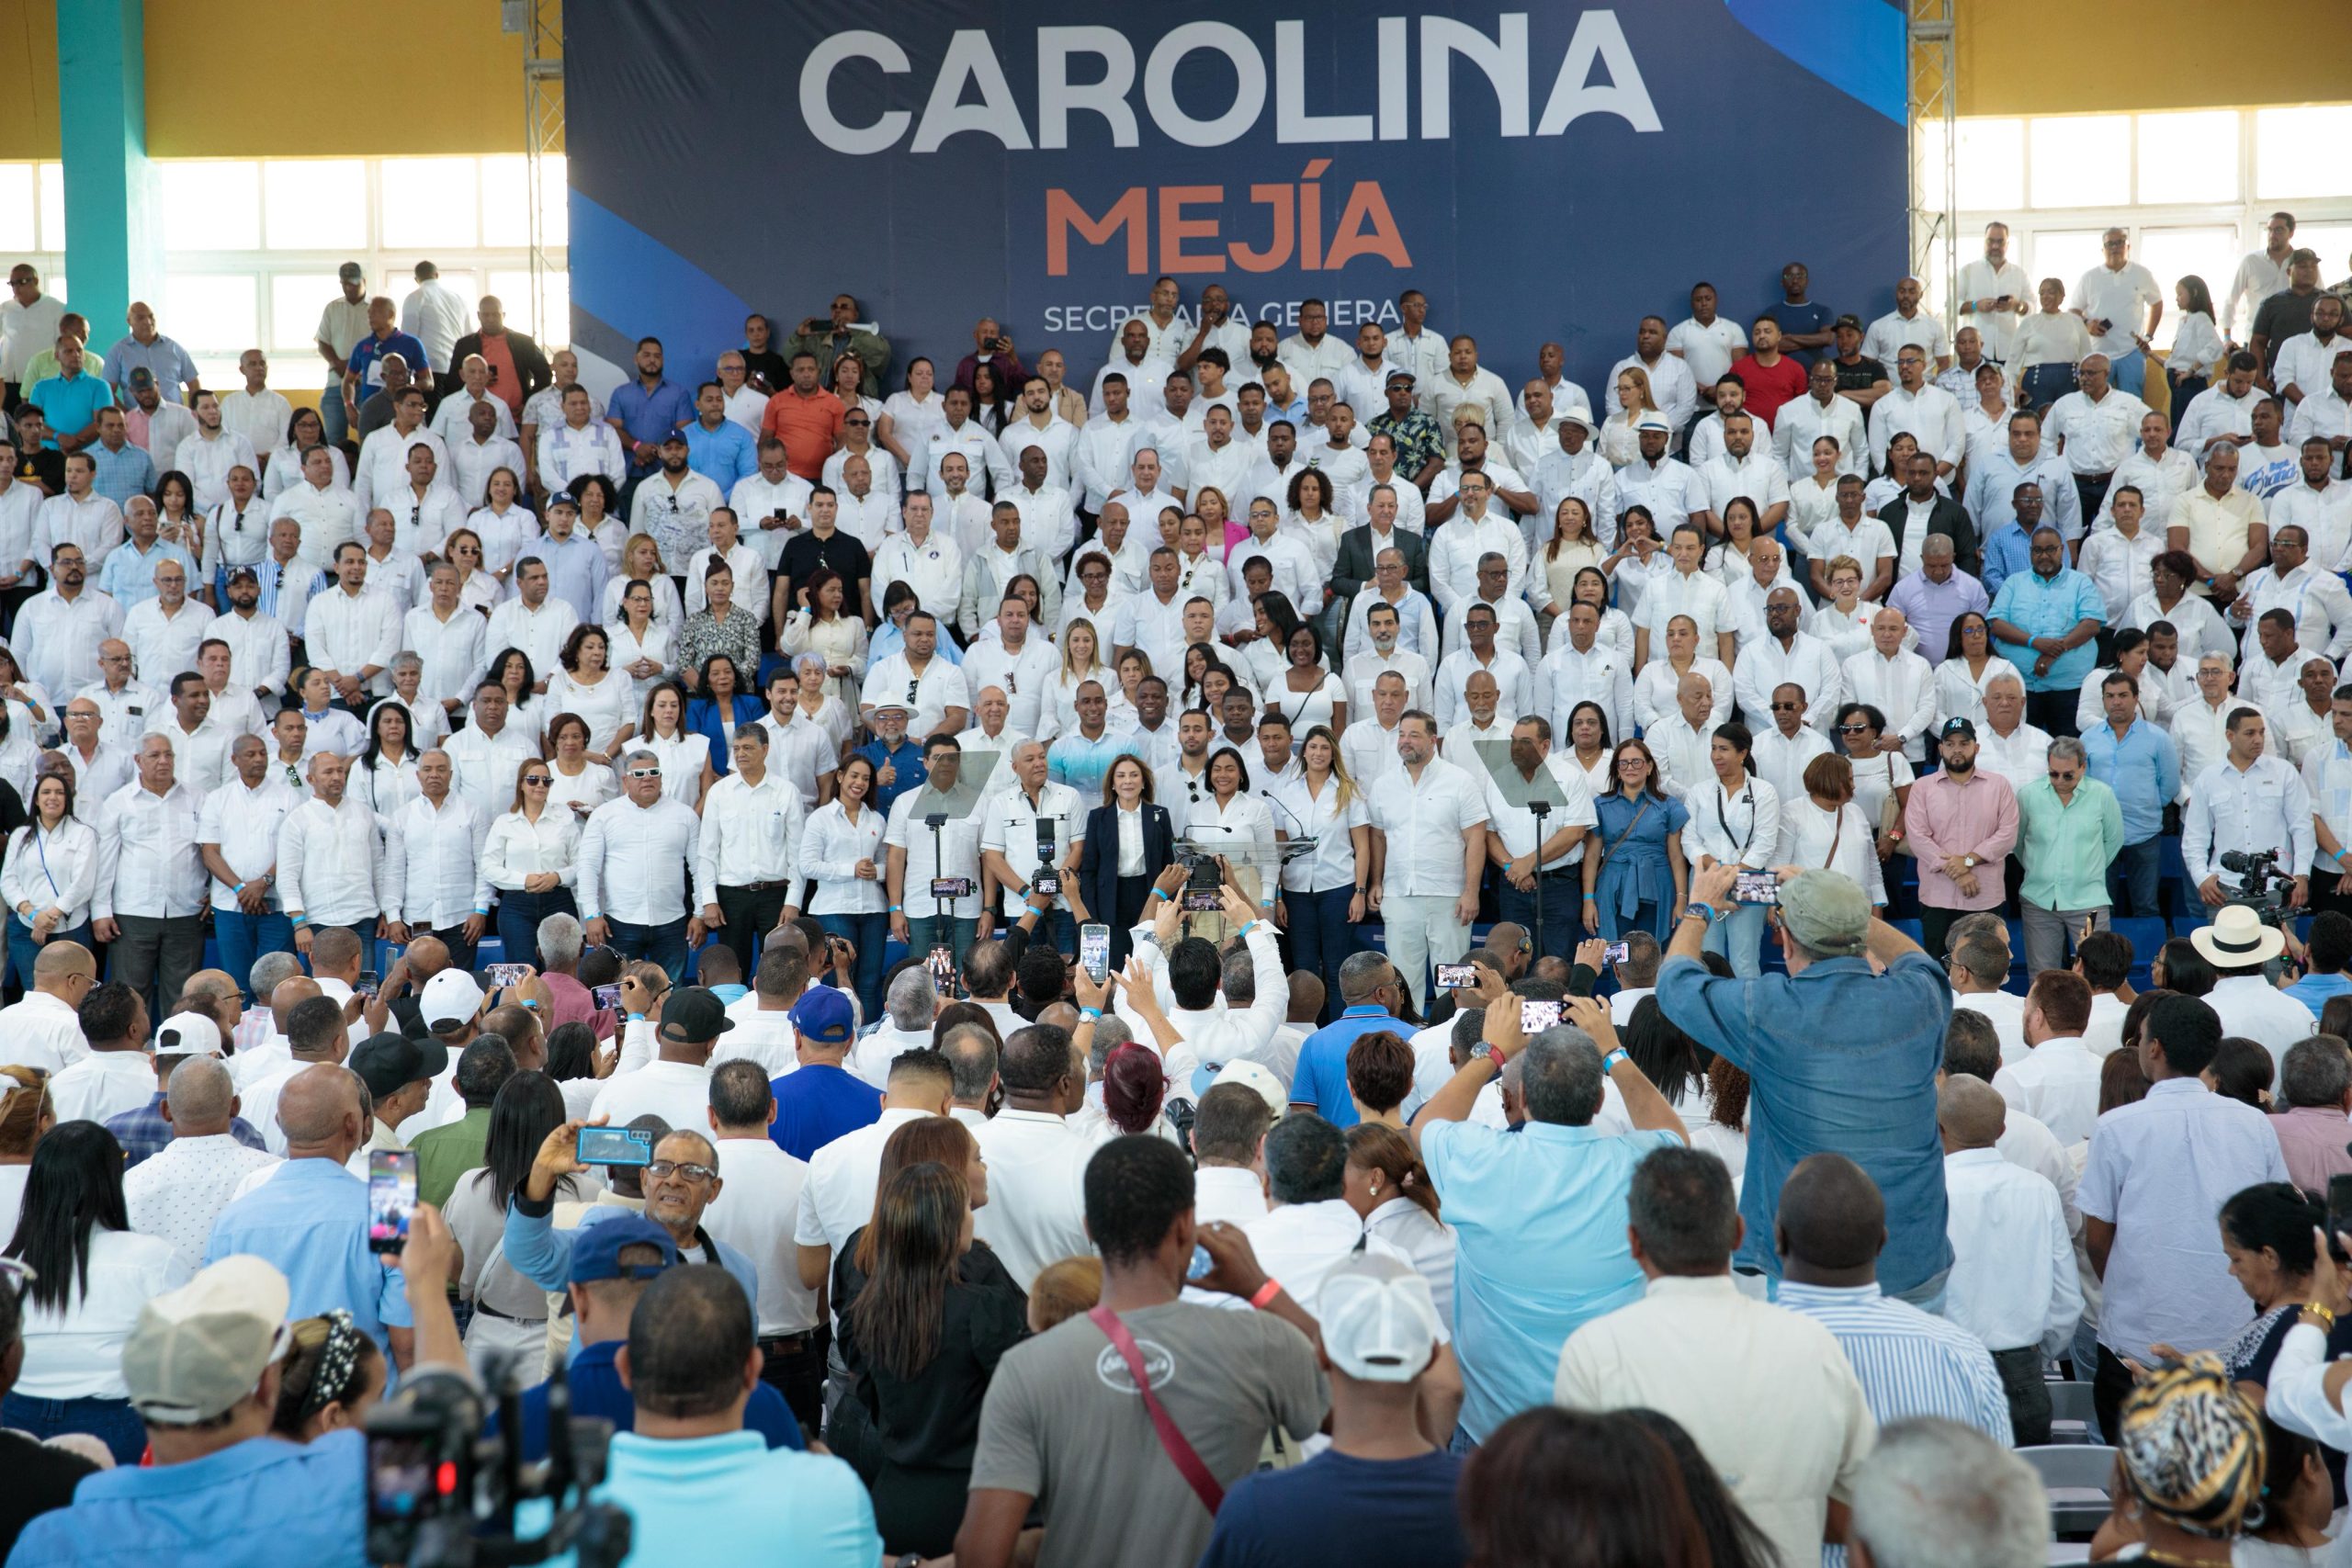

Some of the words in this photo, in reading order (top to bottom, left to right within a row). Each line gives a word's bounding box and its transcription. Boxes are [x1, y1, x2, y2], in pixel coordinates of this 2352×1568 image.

[799, 9, 1664, 155] CAROLINA
[1046, 159, 1412, 276] MEJÍA
[1260, 299, 1406, 327] GEERA
